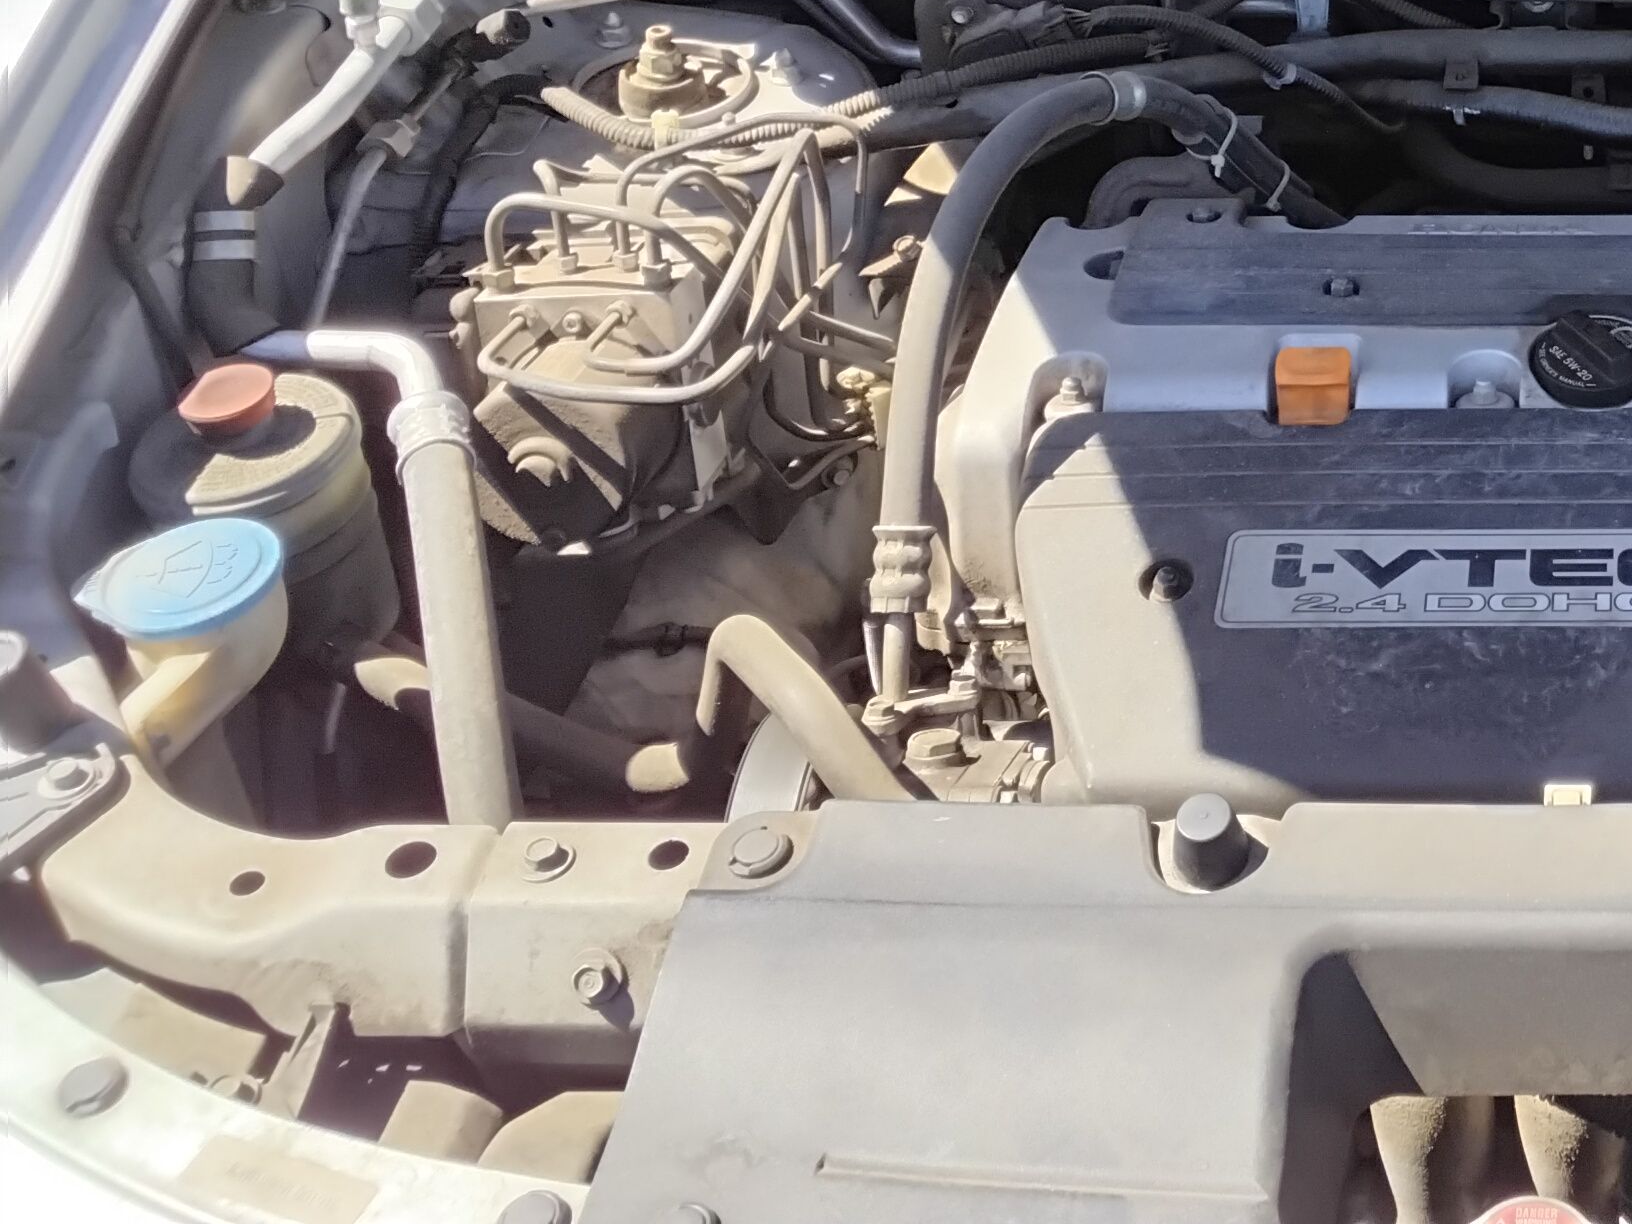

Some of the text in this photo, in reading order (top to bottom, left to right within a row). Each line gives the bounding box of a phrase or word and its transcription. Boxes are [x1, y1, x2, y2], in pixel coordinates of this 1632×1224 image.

[1549, 345, 1593, 381] SAE 5W-20
[1291, 591, 1407, 614] 2.4
